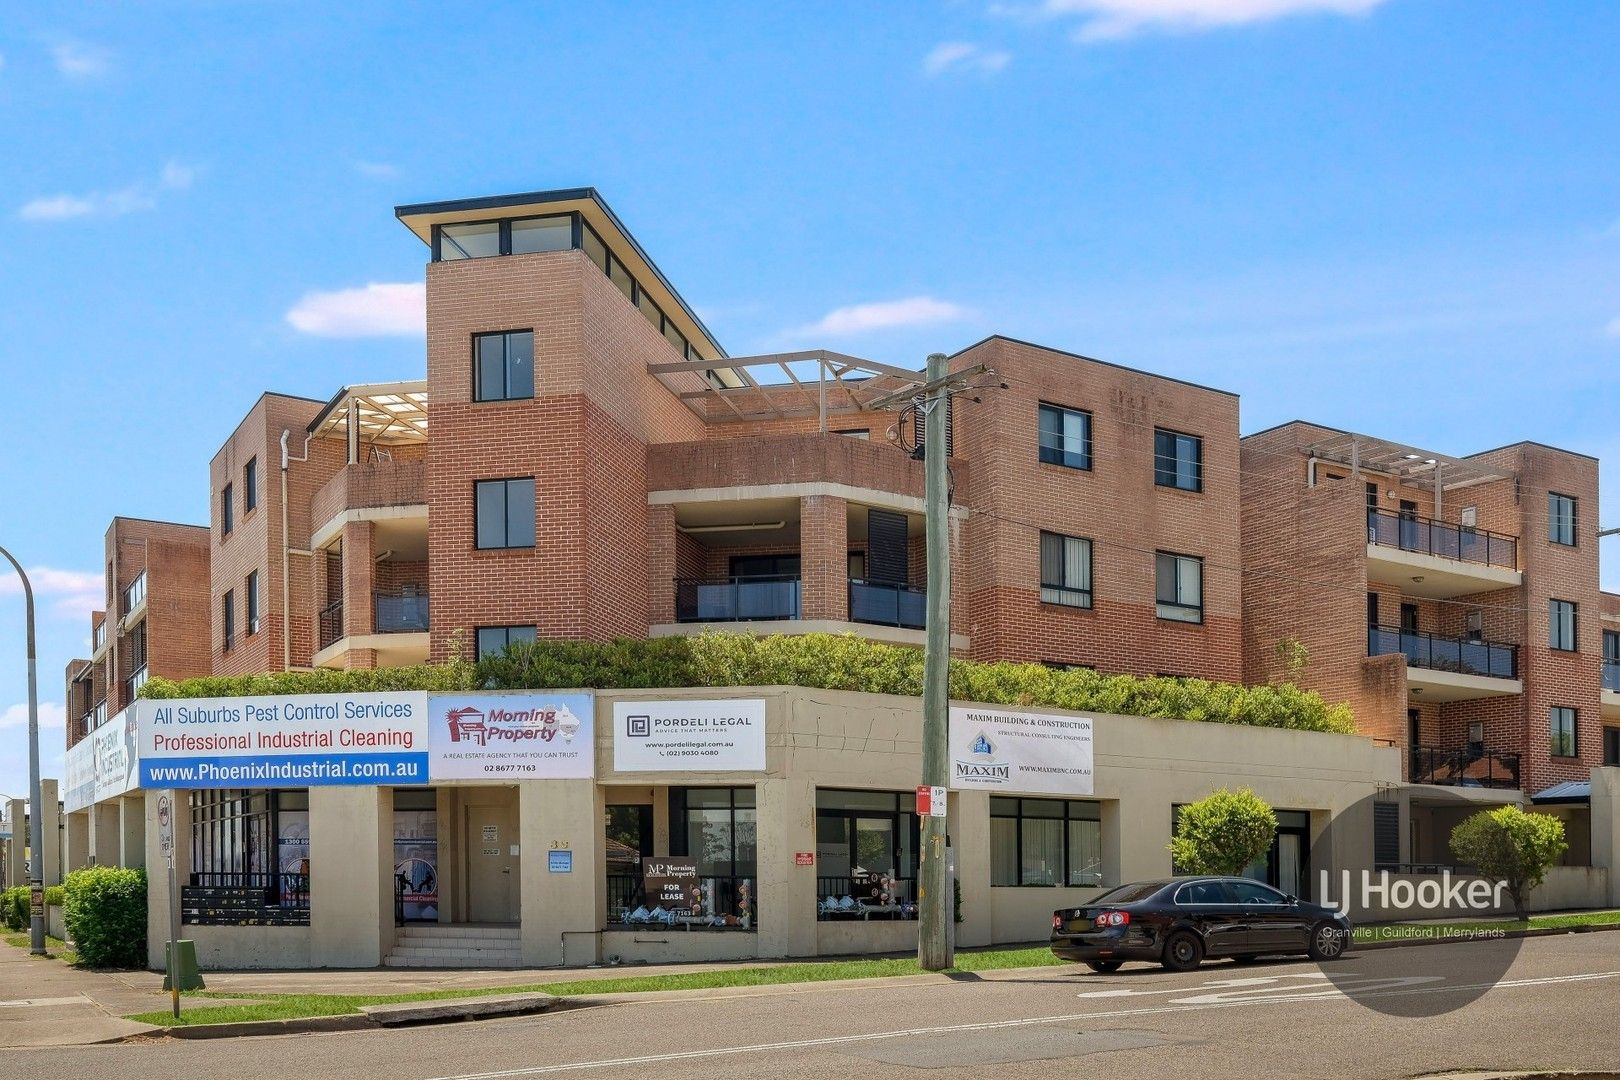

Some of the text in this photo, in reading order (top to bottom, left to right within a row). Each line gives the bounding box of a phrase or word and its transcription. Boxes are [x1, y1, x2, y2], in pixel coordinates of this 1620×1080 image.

[154, 701, 412, 724] All Suburbs Pest Control Services
[488, 708, 556, 724] Morning
[655, 717, 752, 726] PORDELI LEGAL
[966, 714, 992, 722] MAXIM
[994, 716, 1029, 725] BUILDING
[1037, 719, 1090, 729] CONSTRUCTION
[154, 728, 413, 751] Professional Industrial Cleaning
[487, 726, 557, 742] Property
[150, 760, 418, 781] www.PhoenixIndustrial.com.au
[956, 763, 1009, 778] MAXIM
